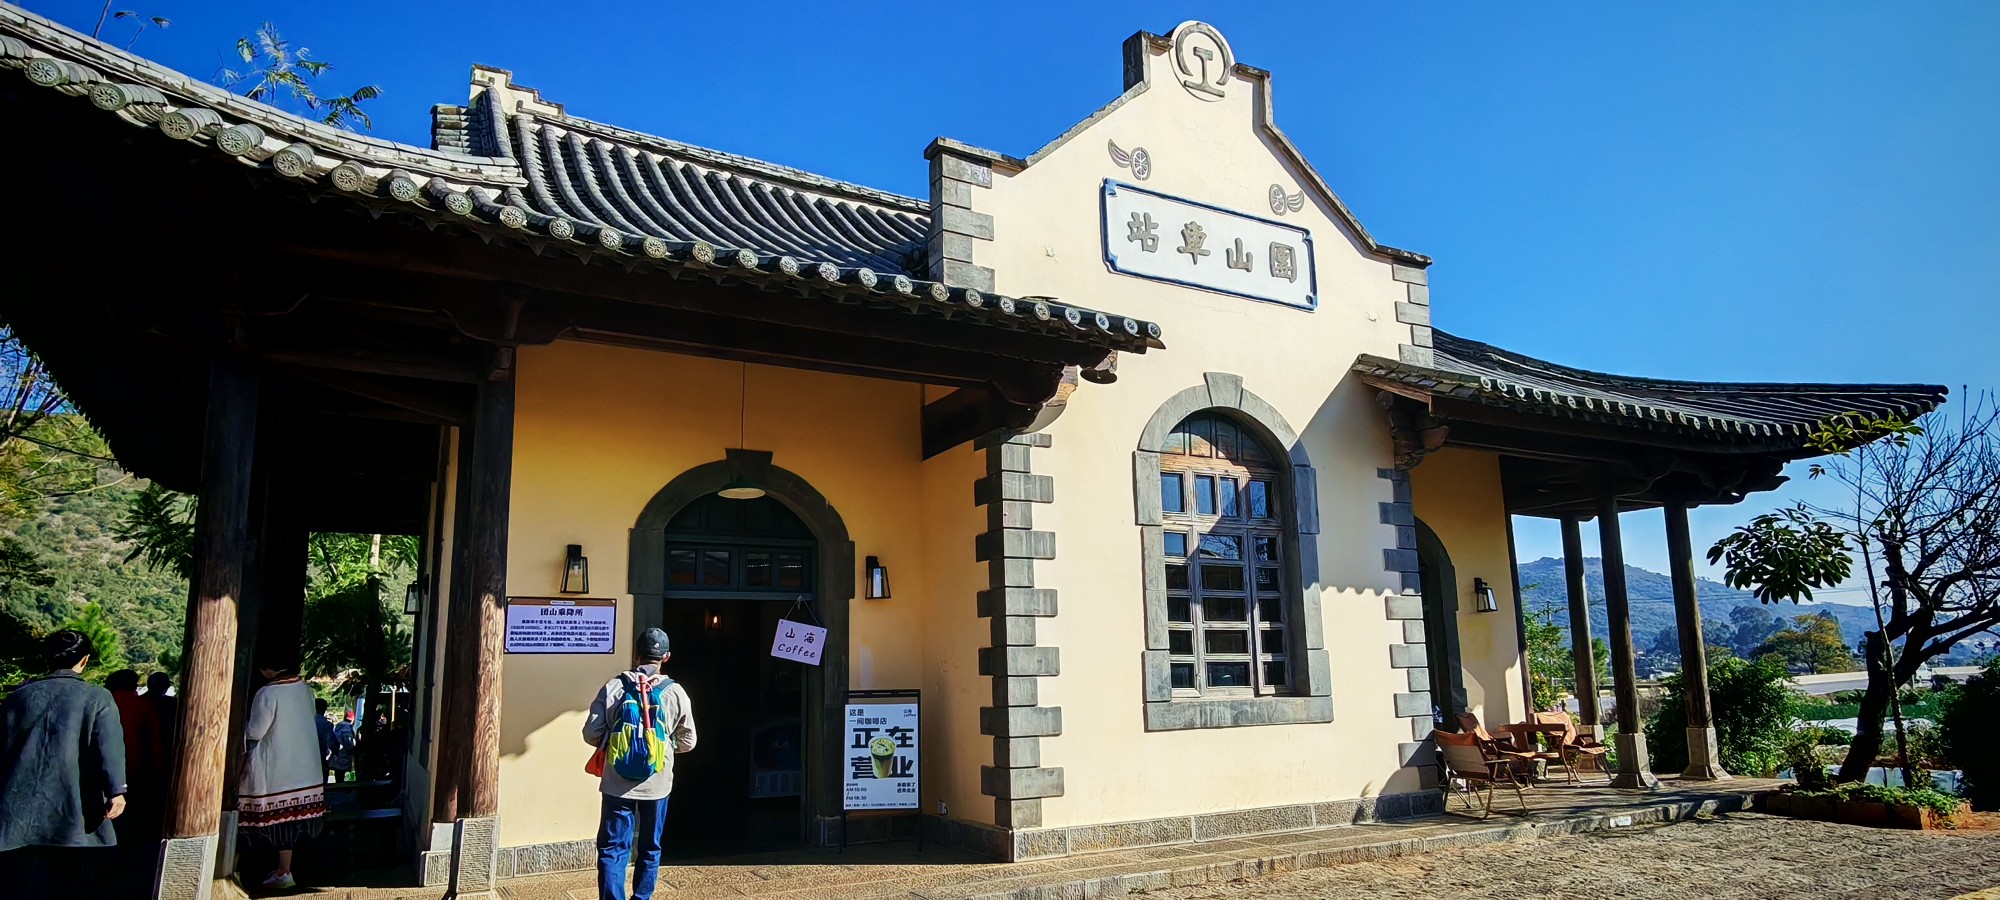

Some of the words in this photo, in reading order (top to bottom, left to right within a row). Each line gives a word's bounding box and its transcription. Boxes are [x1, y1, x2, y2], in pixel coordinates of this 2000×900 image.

[540, 608, 584, 617] 团山乘降所
[785, 628, 815, 644] 山海
[778, 643, 815, 658] Coffee
[849, 709, 865, 717] 这是
[851, 726, 914, 748] 正在
[851, 756, 914, 779] 营业
